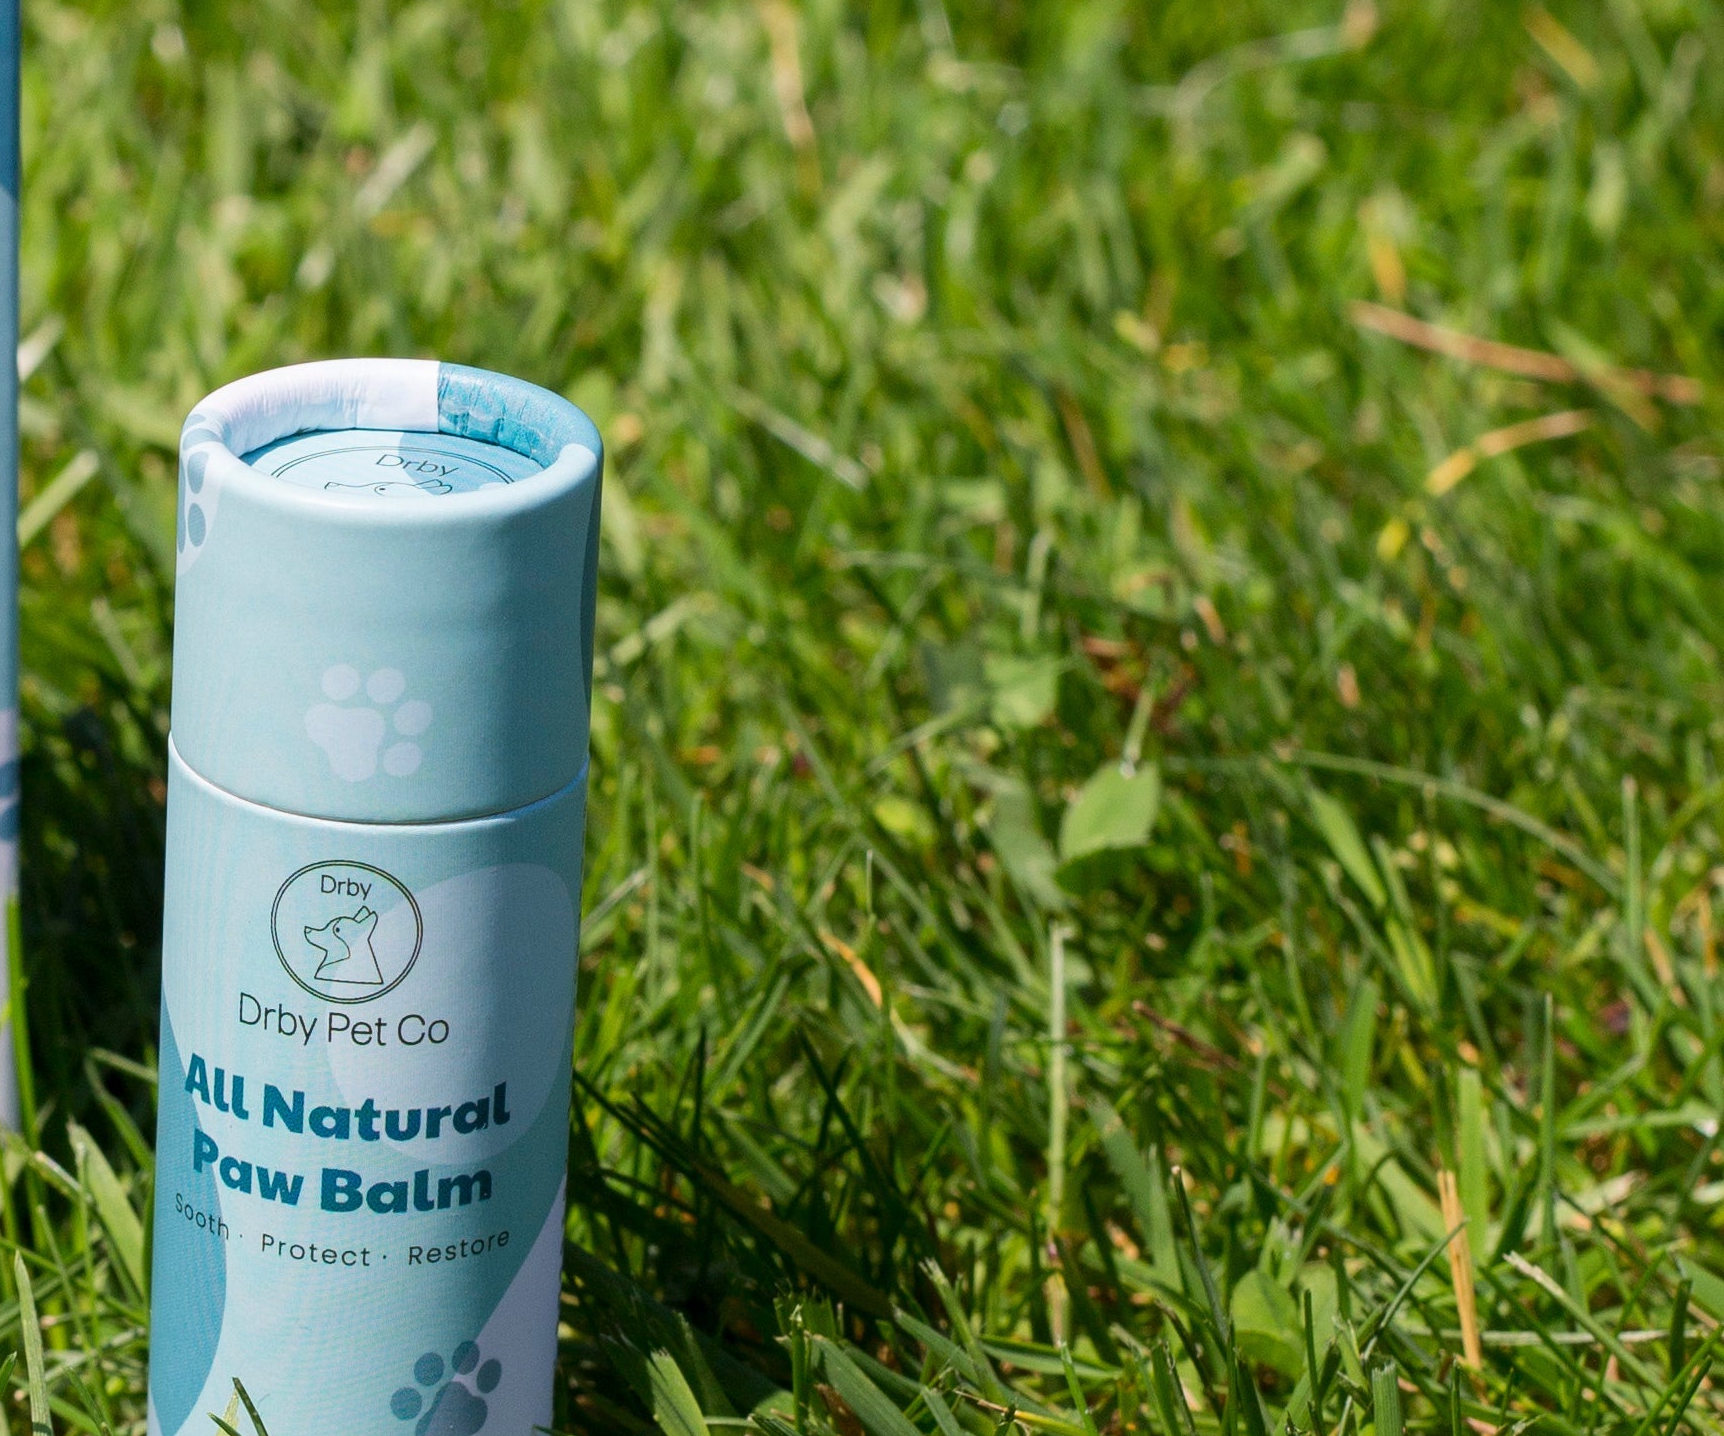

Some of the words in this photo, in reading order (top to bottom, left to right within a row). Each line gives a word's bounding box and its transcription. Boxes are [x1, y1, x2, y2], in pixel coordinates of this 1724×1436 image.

[376, 453, 460, 477] Drby
[320, 874, 373, 901] Drby
[238, 992, 318, 1047] Drby
[327, 1012, 388, 1047] Pet
[397, 1014, 451, 1047] Co
[183, 1052, 250, 1122] All
[262, 1080, 512, 1143] Natural
[192, 1127, 305, 1207] Paw
[320, 1166, 493, 1215] Balm
[174, 1191, 230, 1241] Sooth
[261, 1232, 372, 1268] Protect
[407, 1228, 512, 1267] Restore
